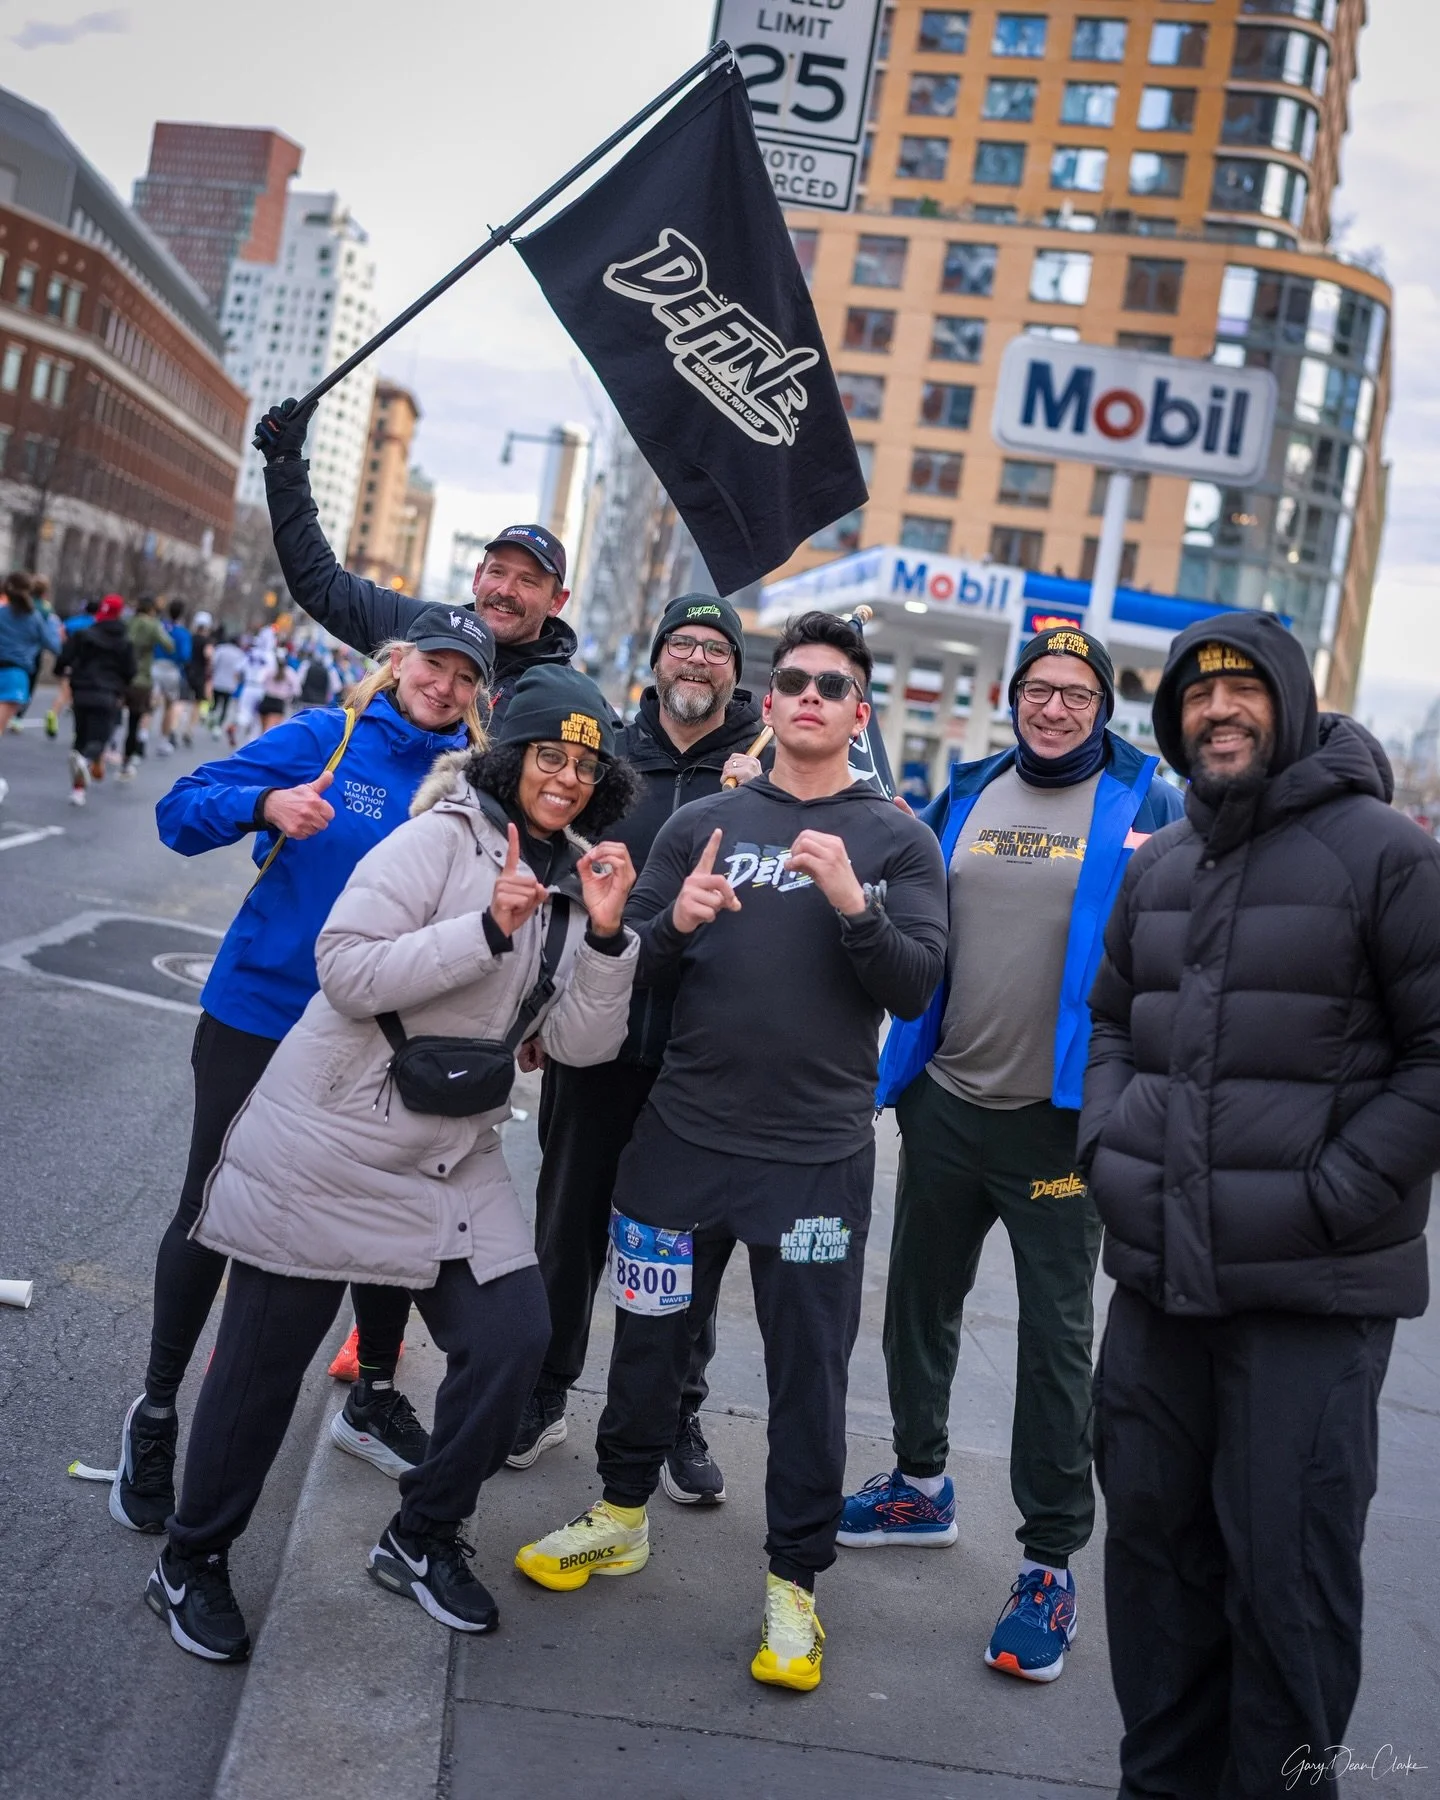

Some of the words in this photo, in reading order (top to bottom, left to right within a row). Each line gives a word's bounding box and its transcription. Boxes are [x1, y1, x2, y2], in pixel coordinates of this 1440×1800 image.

[757, 8, 833, 39] LIMIT
[735, 44, 847, 123] 25
[762, 149, 816, 174] OTO
[774, 173, 838, 200] RCED
[691, 361, 714, 382] NEW
[708, 376, 732, 401] YORK
[727, 395, 748, 414] RUN
[743, 408, 766, 429] CLUB
[1020, 358, 1250, 457] Mobil
[892, 558, 1010, 609] Mobil
[1047, 636, 1067, 645] NEW
[1069, 637, 1090, 652] YORK
[1047, 642, 1066, 650] RUN
[561, 720, 582, 732] NEW
[570, 713, 598, 730] DEFINE
[561, 730, 581, 743] RUN
[344, 780, 387, 798] TOKYO
[344, 790, 385, 806] MARATHON
[345, 797, 383, 820] 2026
[978, 829, 1017, 844] DEFINE
[1016, 831, 1043, 846] NEW
[1045, 833, 1080, 849] YORK
[994, 842, 1019, 857] RUN
[1019, 844, 1051, 859] CLUB
[1030, 1172, 1085, 1200] DEFINE
[794, 1217, 842, 1233] DEFINE
[780, 1232, 813, 1247] NEW
[814, 1230, 851, 1247] YORK
[781, 1246, 811, 1261] RUN
[811, 1245, 848, 1261] CLUB
[617, 1256, 677, 1295] 8800
[559, 1545, 616, 1571] BROOKS
